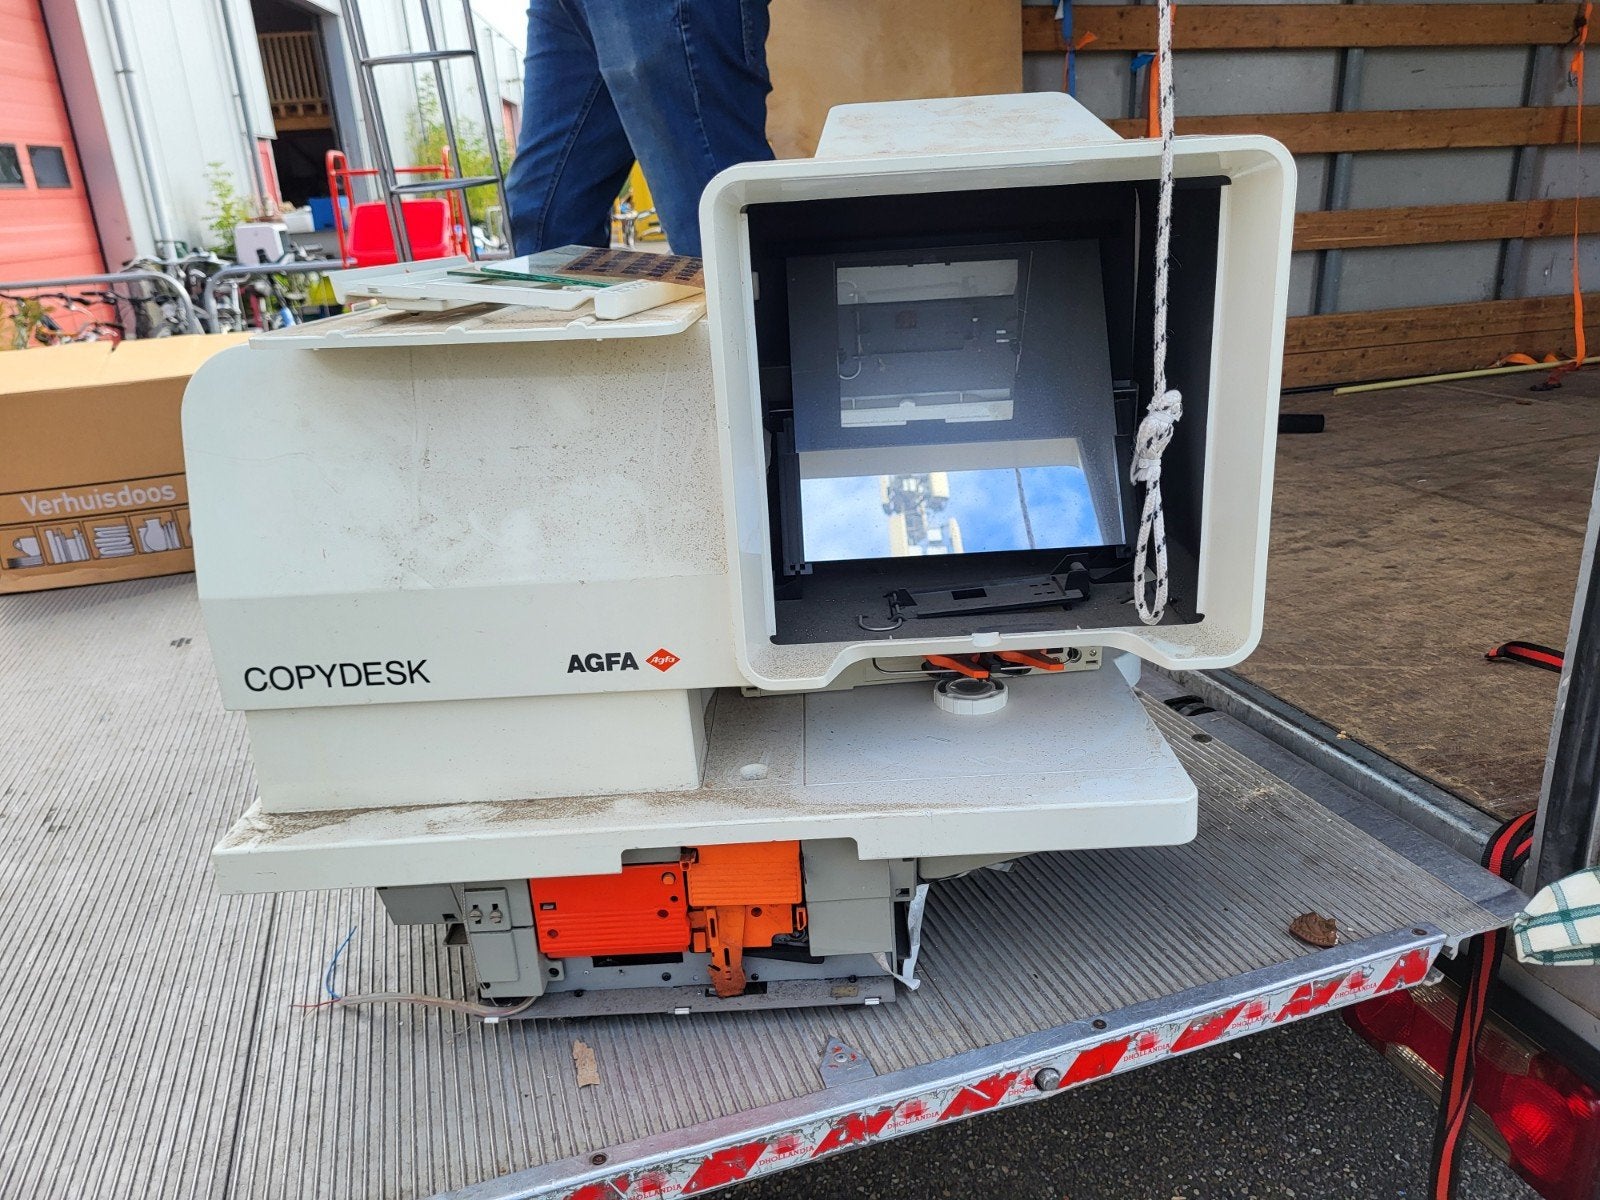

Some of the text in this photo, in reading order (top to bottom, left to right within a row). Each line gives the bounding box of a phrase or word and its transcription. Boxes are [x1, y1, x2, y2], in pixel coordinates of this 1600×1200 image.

[20, 484, 177, 517] Verhuisdoos
[567, 652, 675, 673] AGFA Agfa
[244, 659, 431, 692] COPYDESK
[1123, 1043, 1170, 1062] DHOLLANDIA
[887, 1111, 940, 1130] DHOLLANDIA
[759, 1145, 815, 1166] DHOLLANDIA
